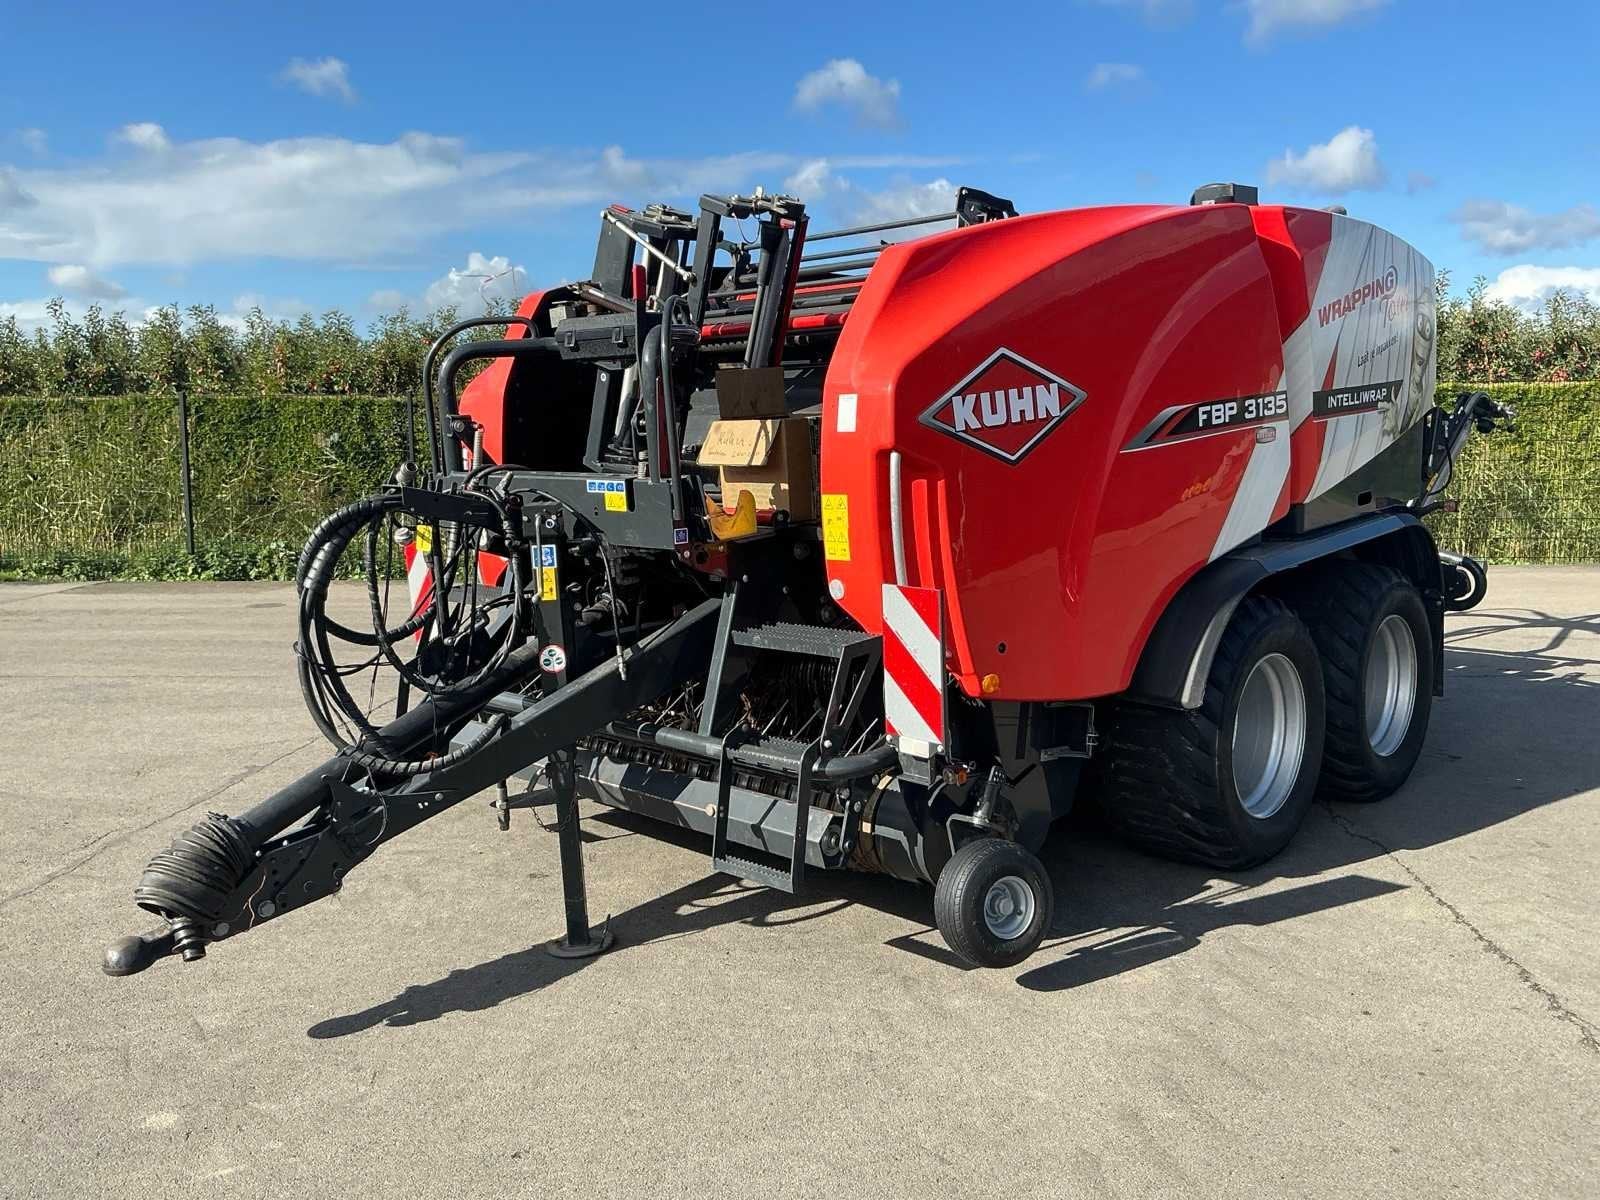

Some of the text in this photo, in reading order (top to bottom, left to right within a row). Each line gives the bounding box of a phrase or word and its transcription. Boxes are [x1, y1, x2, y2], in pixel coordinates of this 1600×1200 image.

[1318, 270, 1396, 328] WRAPPING
[952, 383, 1060, 432] KUHN
[1198, 394, 1287, 427] FBP 3135
[1327, 388, 1387, 409] INTELLIWRAP
